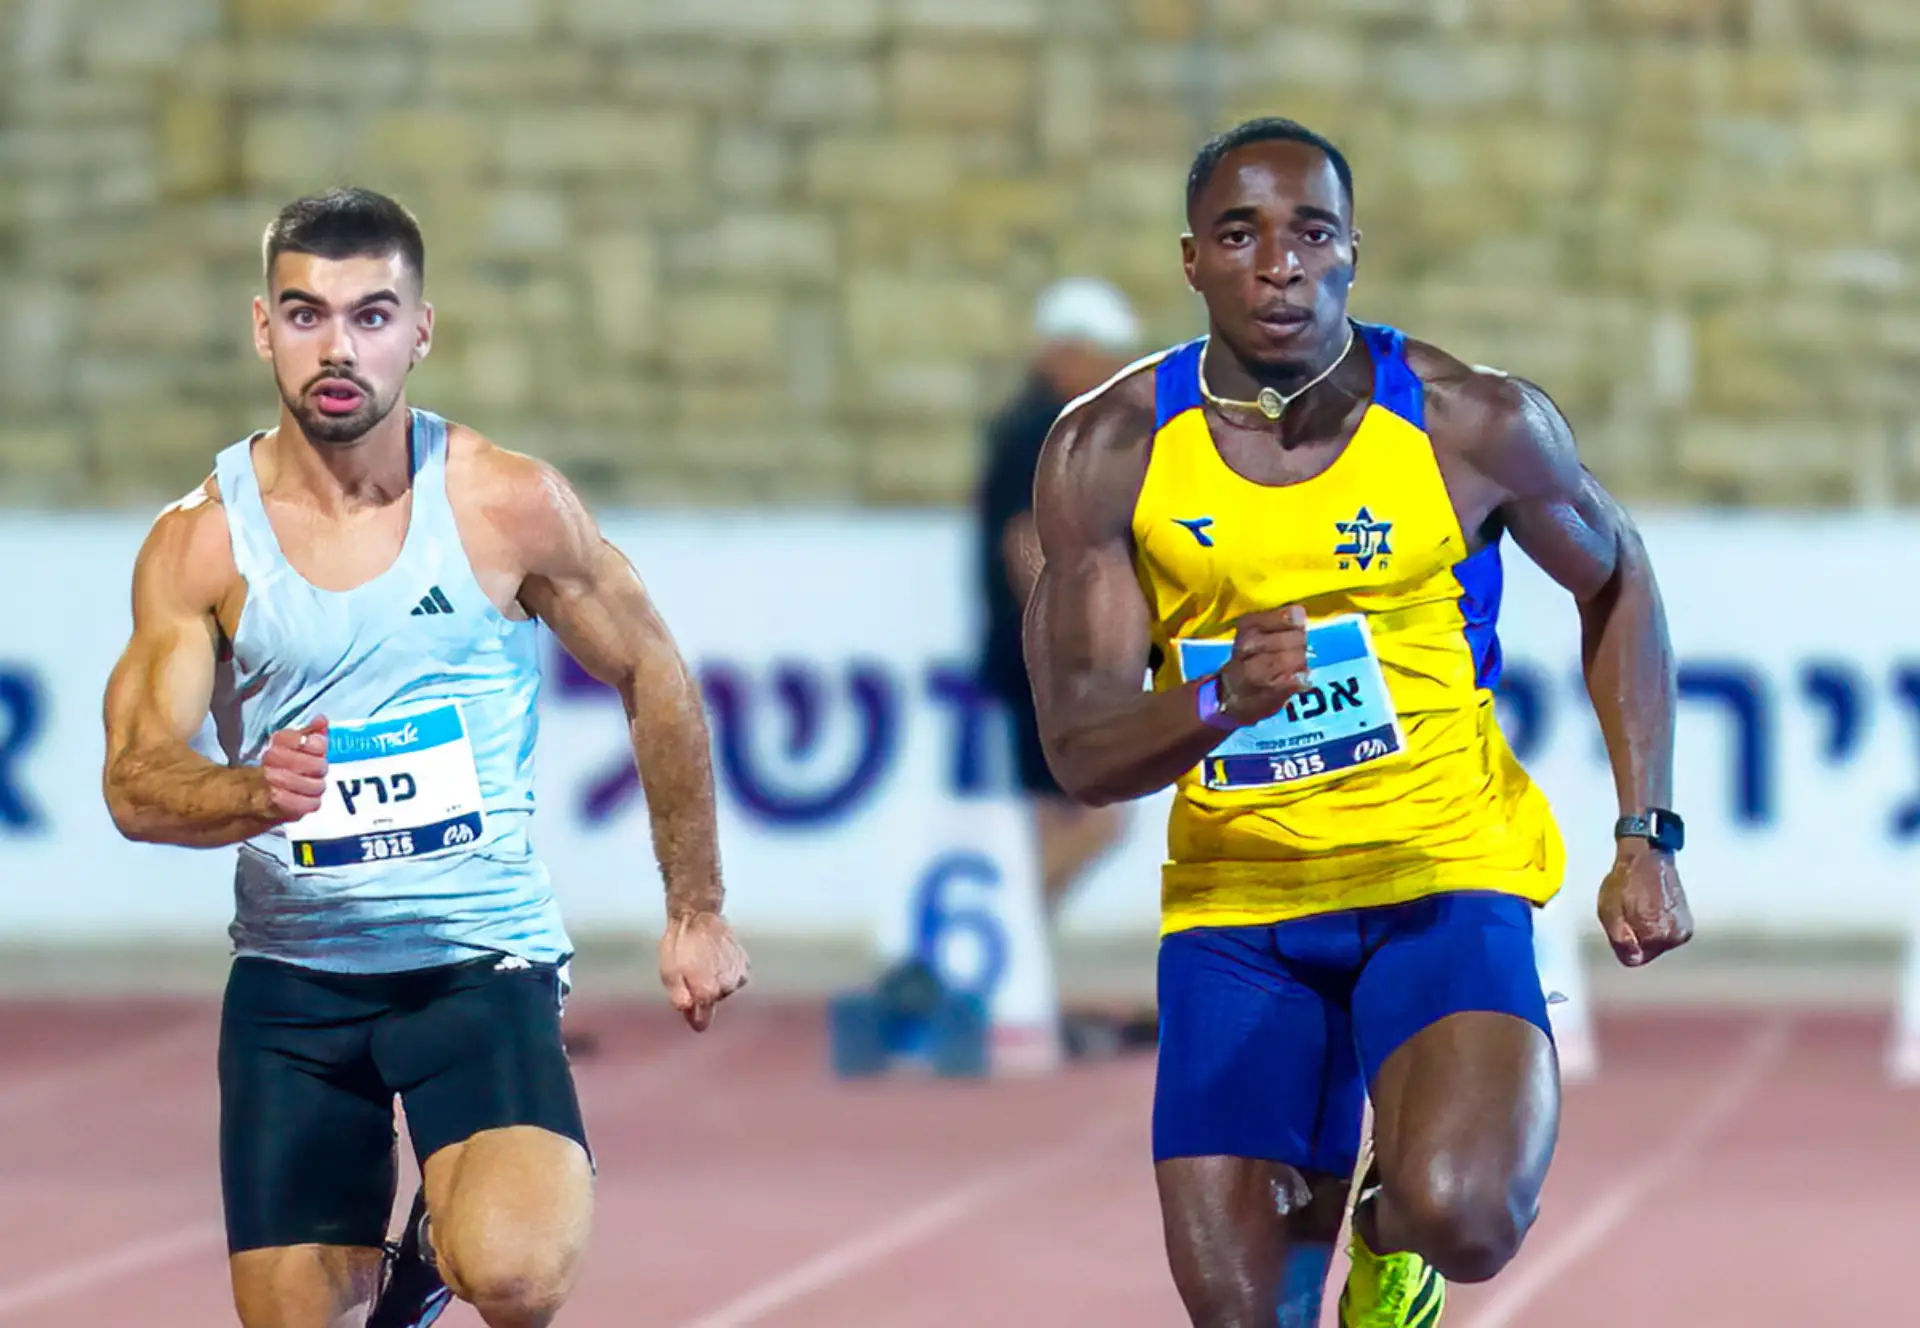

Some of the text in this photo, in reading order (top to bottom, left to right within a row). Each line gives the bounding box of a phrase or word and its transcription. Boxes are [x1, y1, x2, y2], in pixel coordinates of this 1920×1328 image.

[1270, 754, 1325, 780] 2025
[336, 771, 418, 816] פרץ
[360, 835, 415, 861] 2025
[912, 850, 1011, 998] 6
